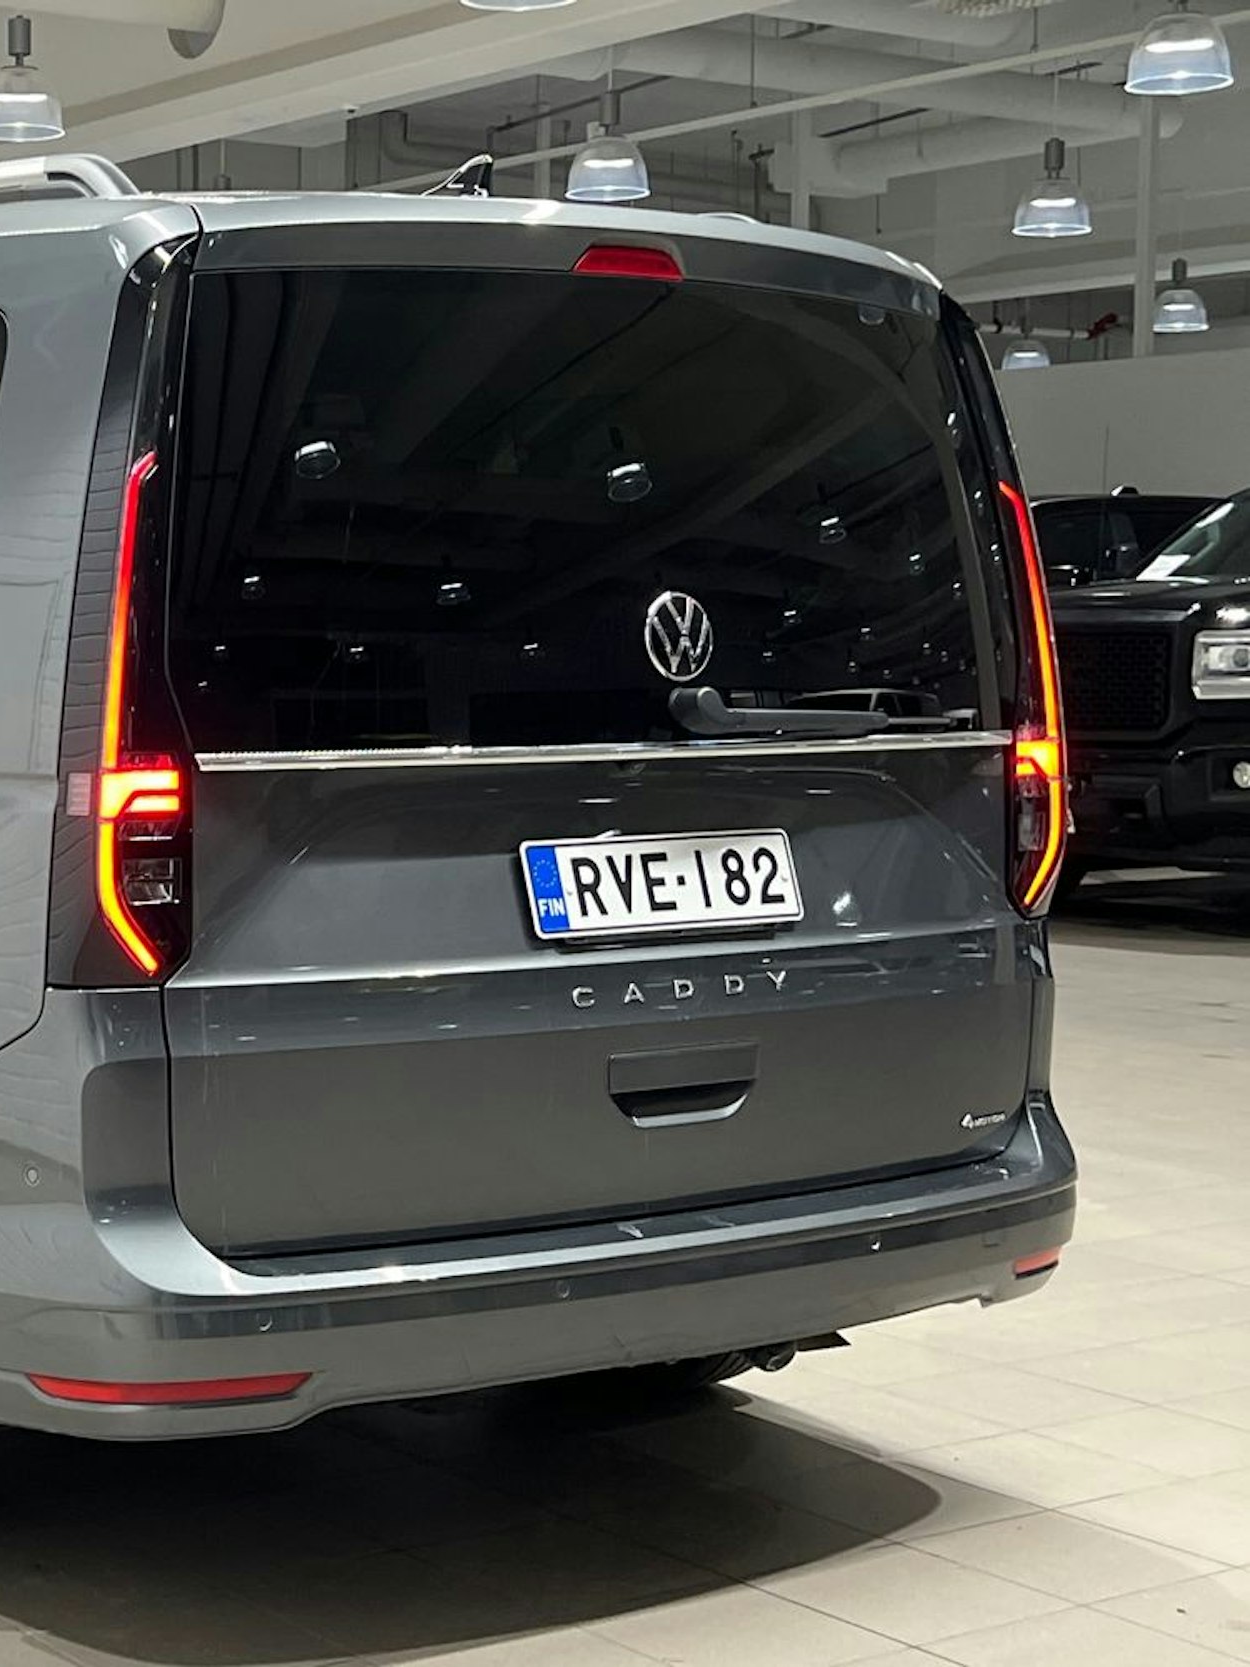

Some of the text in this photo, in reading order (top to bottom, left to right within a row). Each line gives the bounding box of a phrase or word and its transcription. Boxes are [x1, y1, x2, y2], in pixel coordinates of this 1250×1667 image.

[570, 848, 786, 917] RVE-182
[538, 897, 566, 918] FIN
[572, 970, 787, 1008] CADDY
